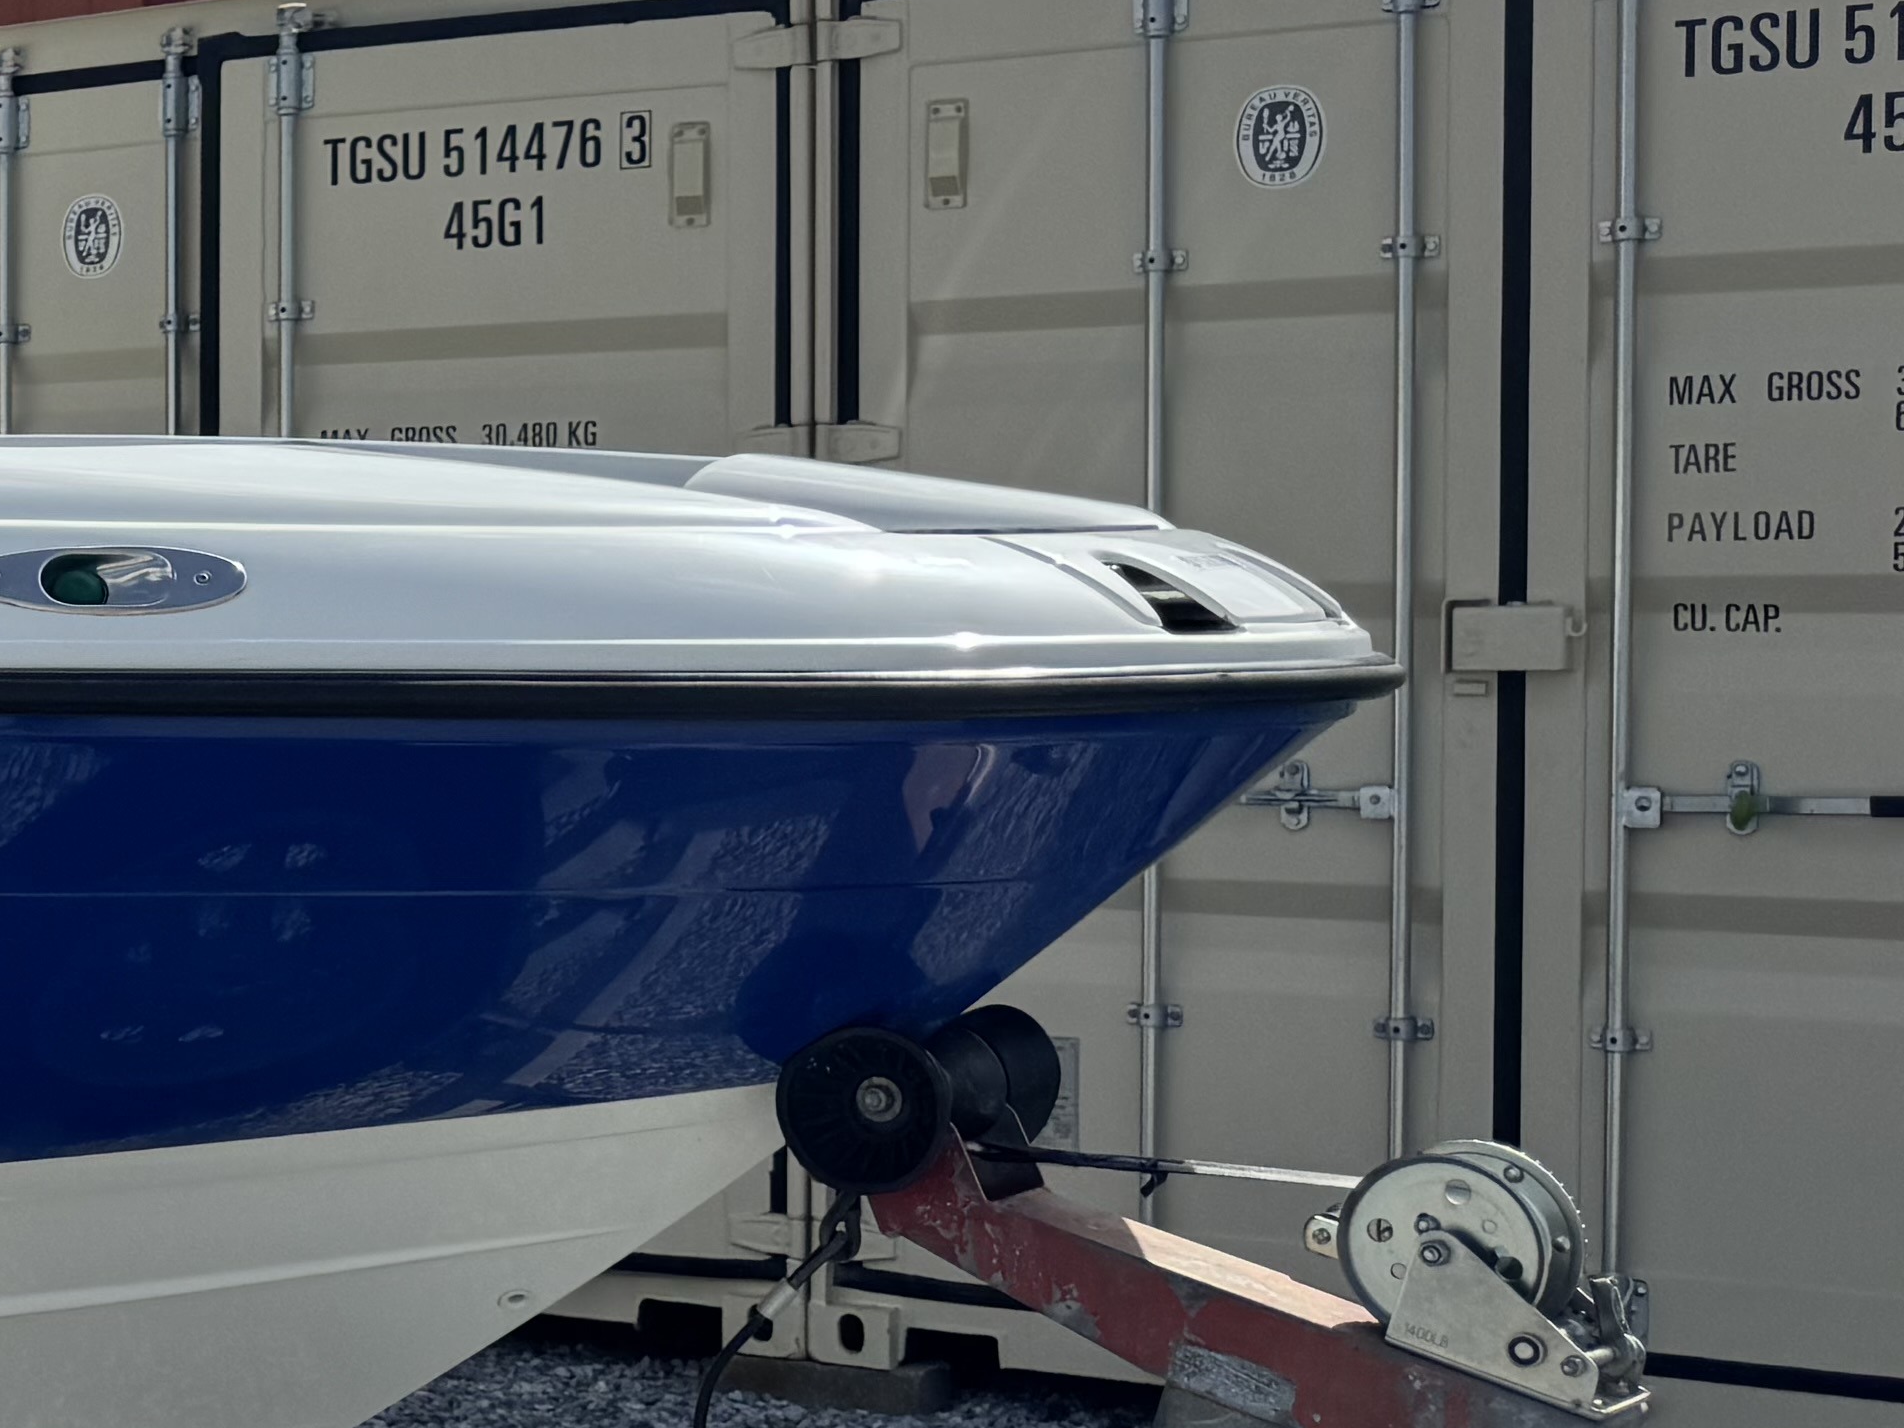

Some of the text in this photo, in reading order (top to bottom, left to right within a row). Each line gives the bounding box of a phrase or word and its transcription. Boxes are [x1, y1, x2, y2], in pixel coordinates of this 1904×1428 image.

[1675, 8, 1820, 78] TGSU
[324, 113, 648, 186] TGSU 514476 3
[443, 195, 544, 250] 45G1
[1668, 373, 1737, 405] MAX
[1766, 368, 1862, 402] GROSS
[481, 421, 558, 448] 30.480
[567, 420, 598, 448] KG
[1668, 441, 1737, 474] TARE
[1666, 509, 1816, 542] PAYLOAD
[1673, 602, 1783, 634] CU. CAP.
